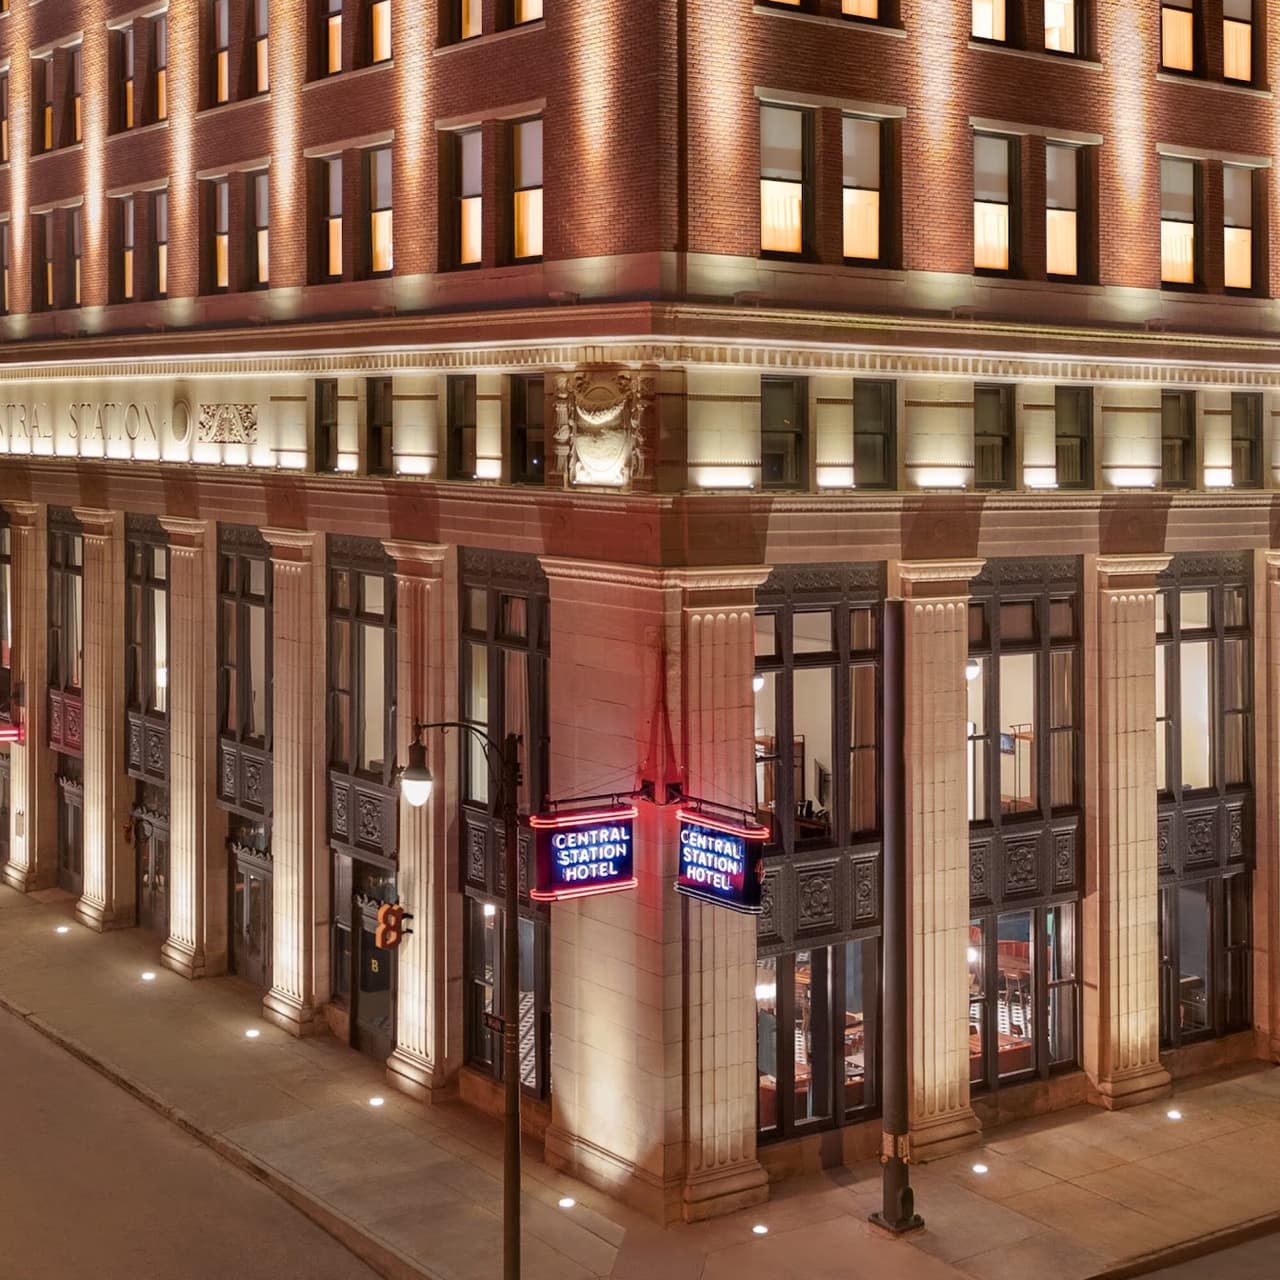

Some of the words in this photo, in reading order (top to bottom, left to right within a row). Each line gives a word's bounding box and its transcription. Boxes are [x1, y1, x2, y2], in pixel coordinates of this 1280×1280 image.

[69, 402, 157, 441] STATION
[554, 826, 630, 849] CENTRAL
[680, 830, 741, 860] CENTRAL
[559, 843, 626, 866] STATION
[683, 846, 737, 875] STATION
[565, 861, 618, 882] HOTEL
[686, 865, 730, 891] HOTEL
